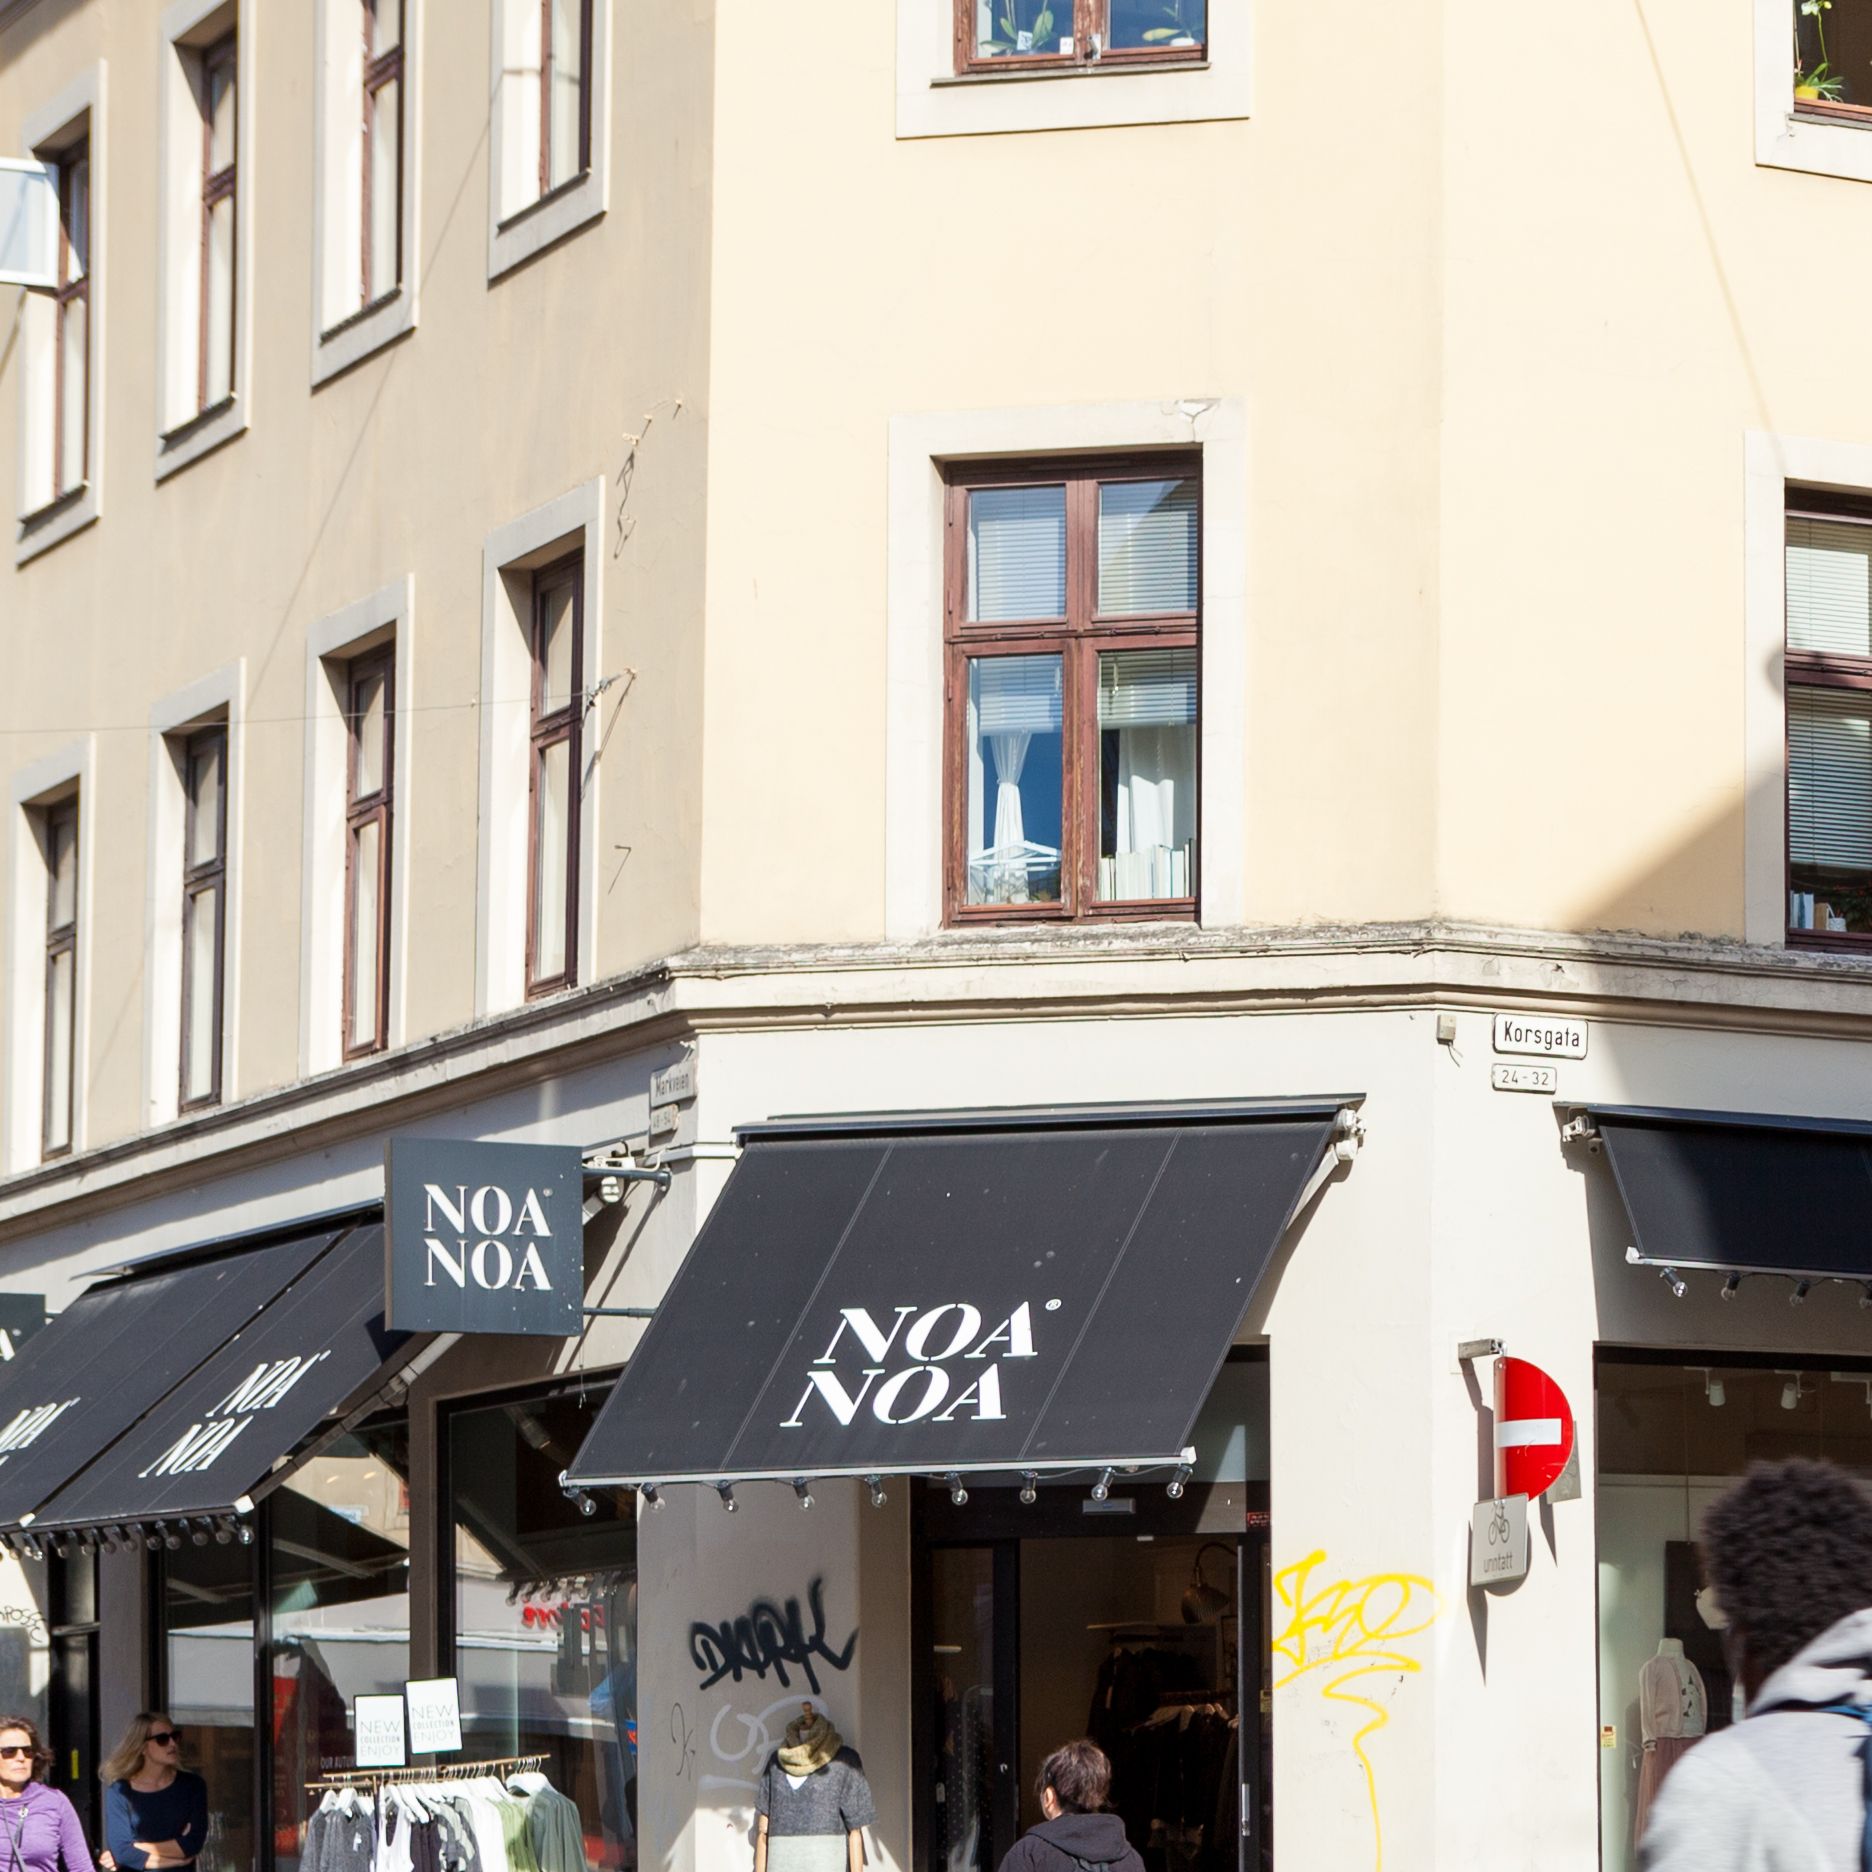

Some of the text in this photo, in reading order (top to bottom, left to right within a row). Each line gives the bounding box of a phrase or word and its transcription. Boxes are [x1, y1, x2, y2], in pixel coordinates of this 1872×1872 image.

[1504, 1021, 1580, 1050] Korsgata
[1502, 1070, 1549, 1085] 24-32
[424, 1238, 553, 1290] NOA
[780, 1363, 1007, 1427] NOA
[138, 1415, 254, 1478] NOA
[1483, 1552, 1513, 1573] unntatt
[412, 1704, 454, 1719] NEW
[360, 1720, 400, 1734] NEW
[360, 1745, 400, 1757] ENJOY
